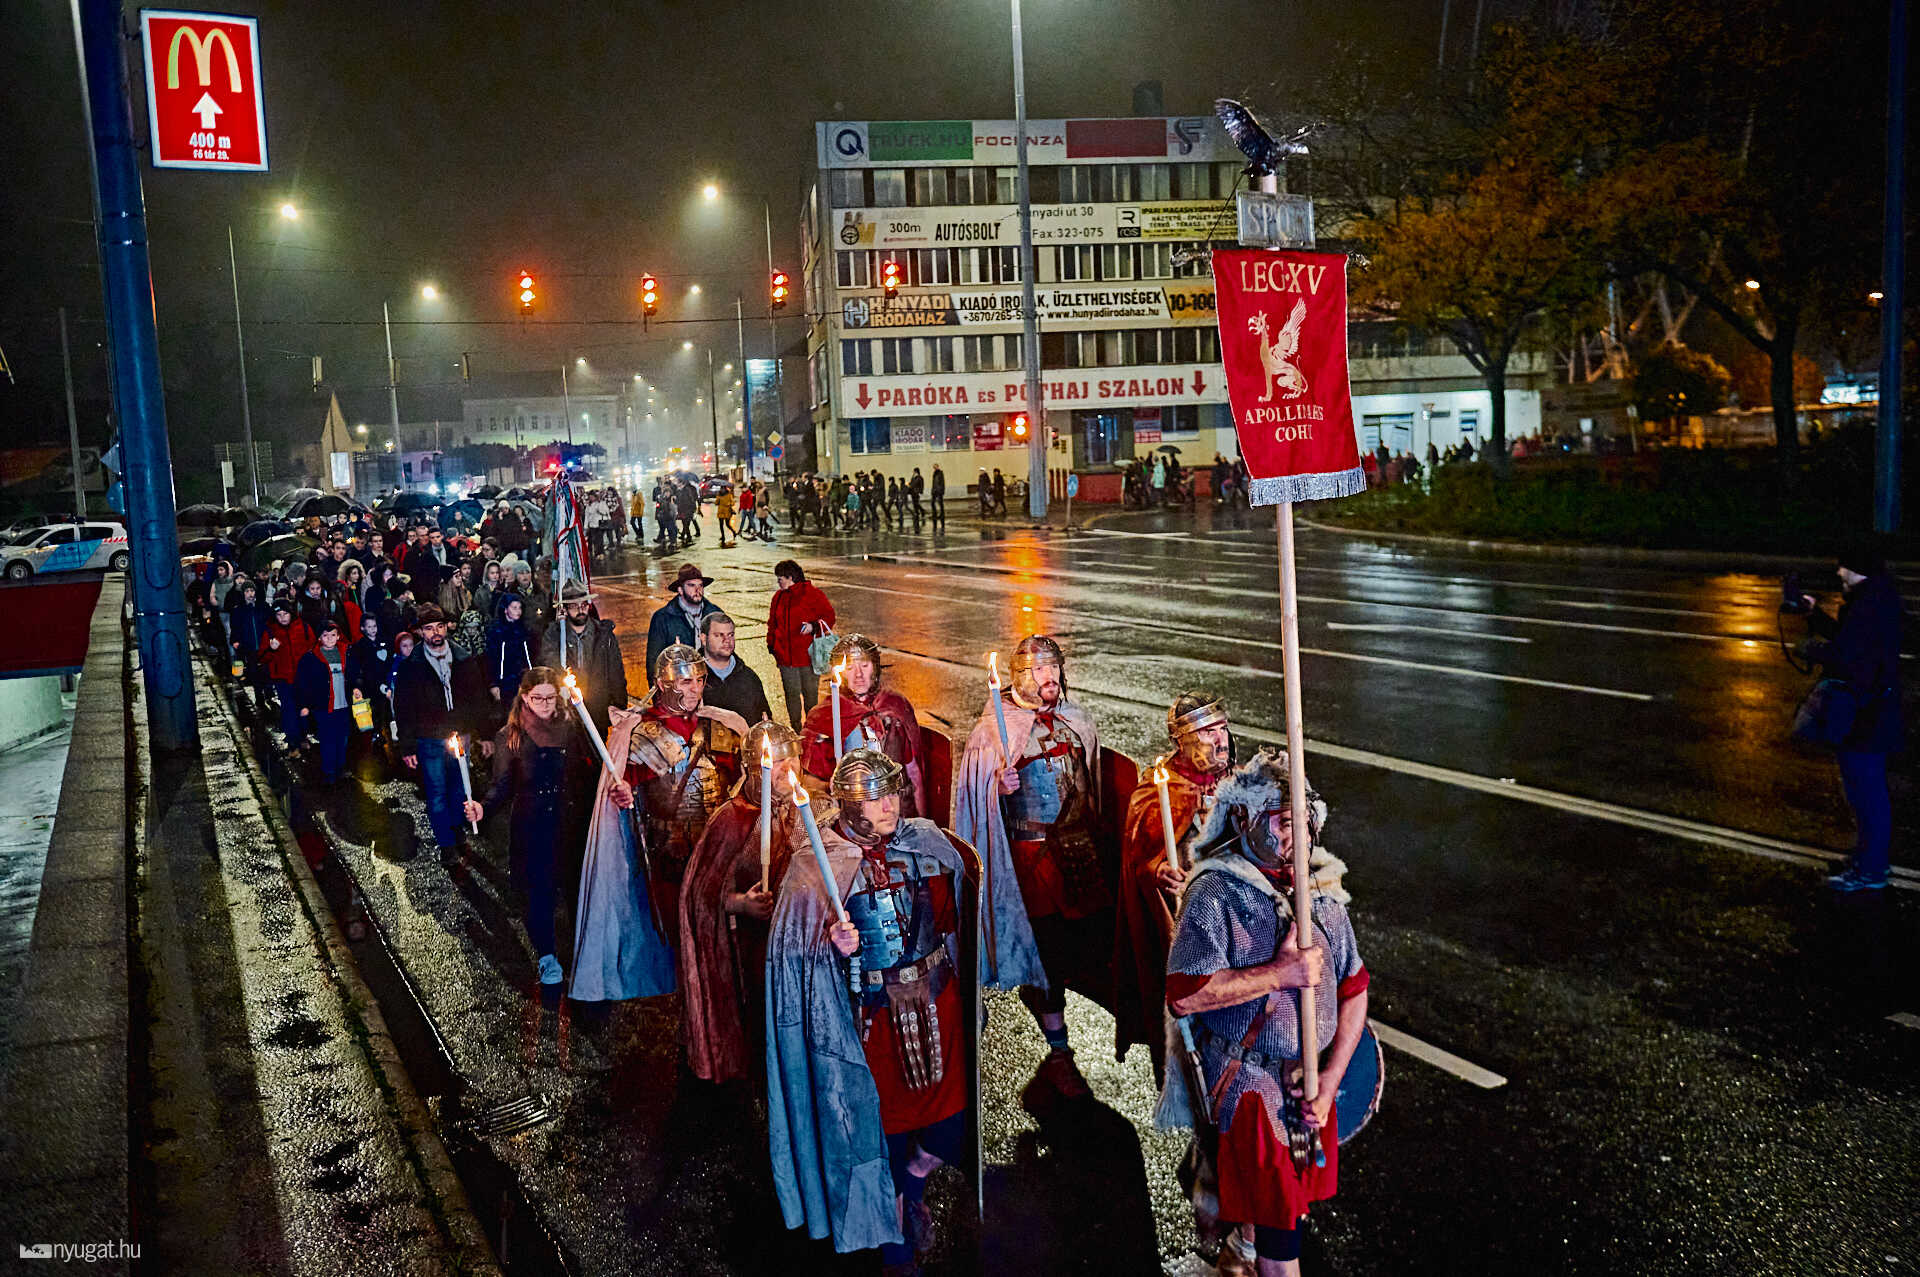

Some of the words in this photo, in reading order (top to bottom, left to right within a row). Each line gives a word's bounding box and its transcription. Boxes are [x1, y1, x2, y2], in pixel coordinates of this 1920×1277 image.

[189, 131, 215, 148] 400
[218, 136, 231, 149] m
[974, 136, 1064, 147] FOCNZA
[1016, 206, 1063, 220] Hnyadi
[1080, 206, 1094, 217] 30
[889, 222, 921, 233] 300m
[935, 218, 1001, 241] AUTÓSBOLT
[1057, 227, 1104, 238] 323-075
[959, 293, 997, 310] KIADÓ
[1000, 294, 1049, 309] IROK,
[1053, 288, 1161, 307] ÜZLETHELYISÉGEK
[877, 382, 969, 407] PARÓKA
[1098, 377, 1184, 399] SZALON
